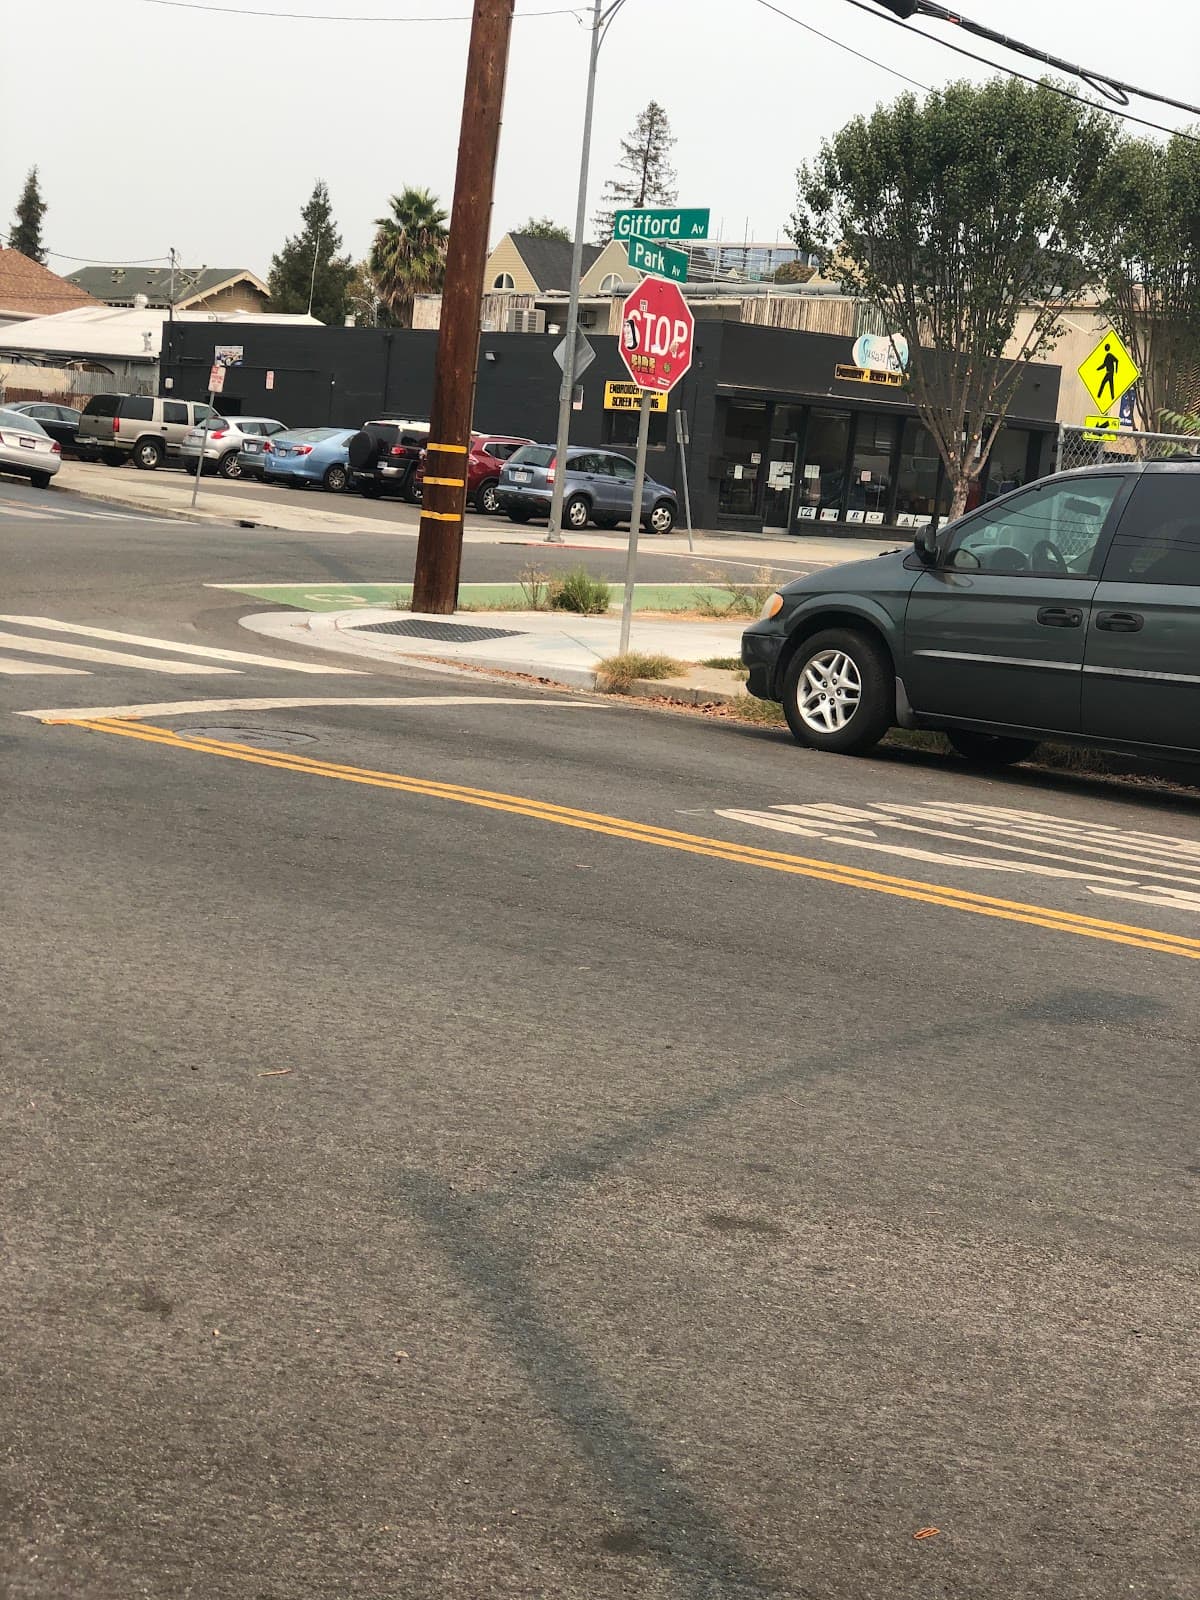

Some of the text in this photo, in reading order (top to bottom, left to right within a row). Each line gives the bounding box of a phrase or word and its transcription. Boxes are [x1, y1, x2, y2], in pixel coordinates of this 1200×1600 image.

[618, 214, 704, 235] Gifford Av
[635, 242, 680, 277] Park Av
[625, 309, 688, 358] STOP
[612, 396, 632, 407] SCREEN
